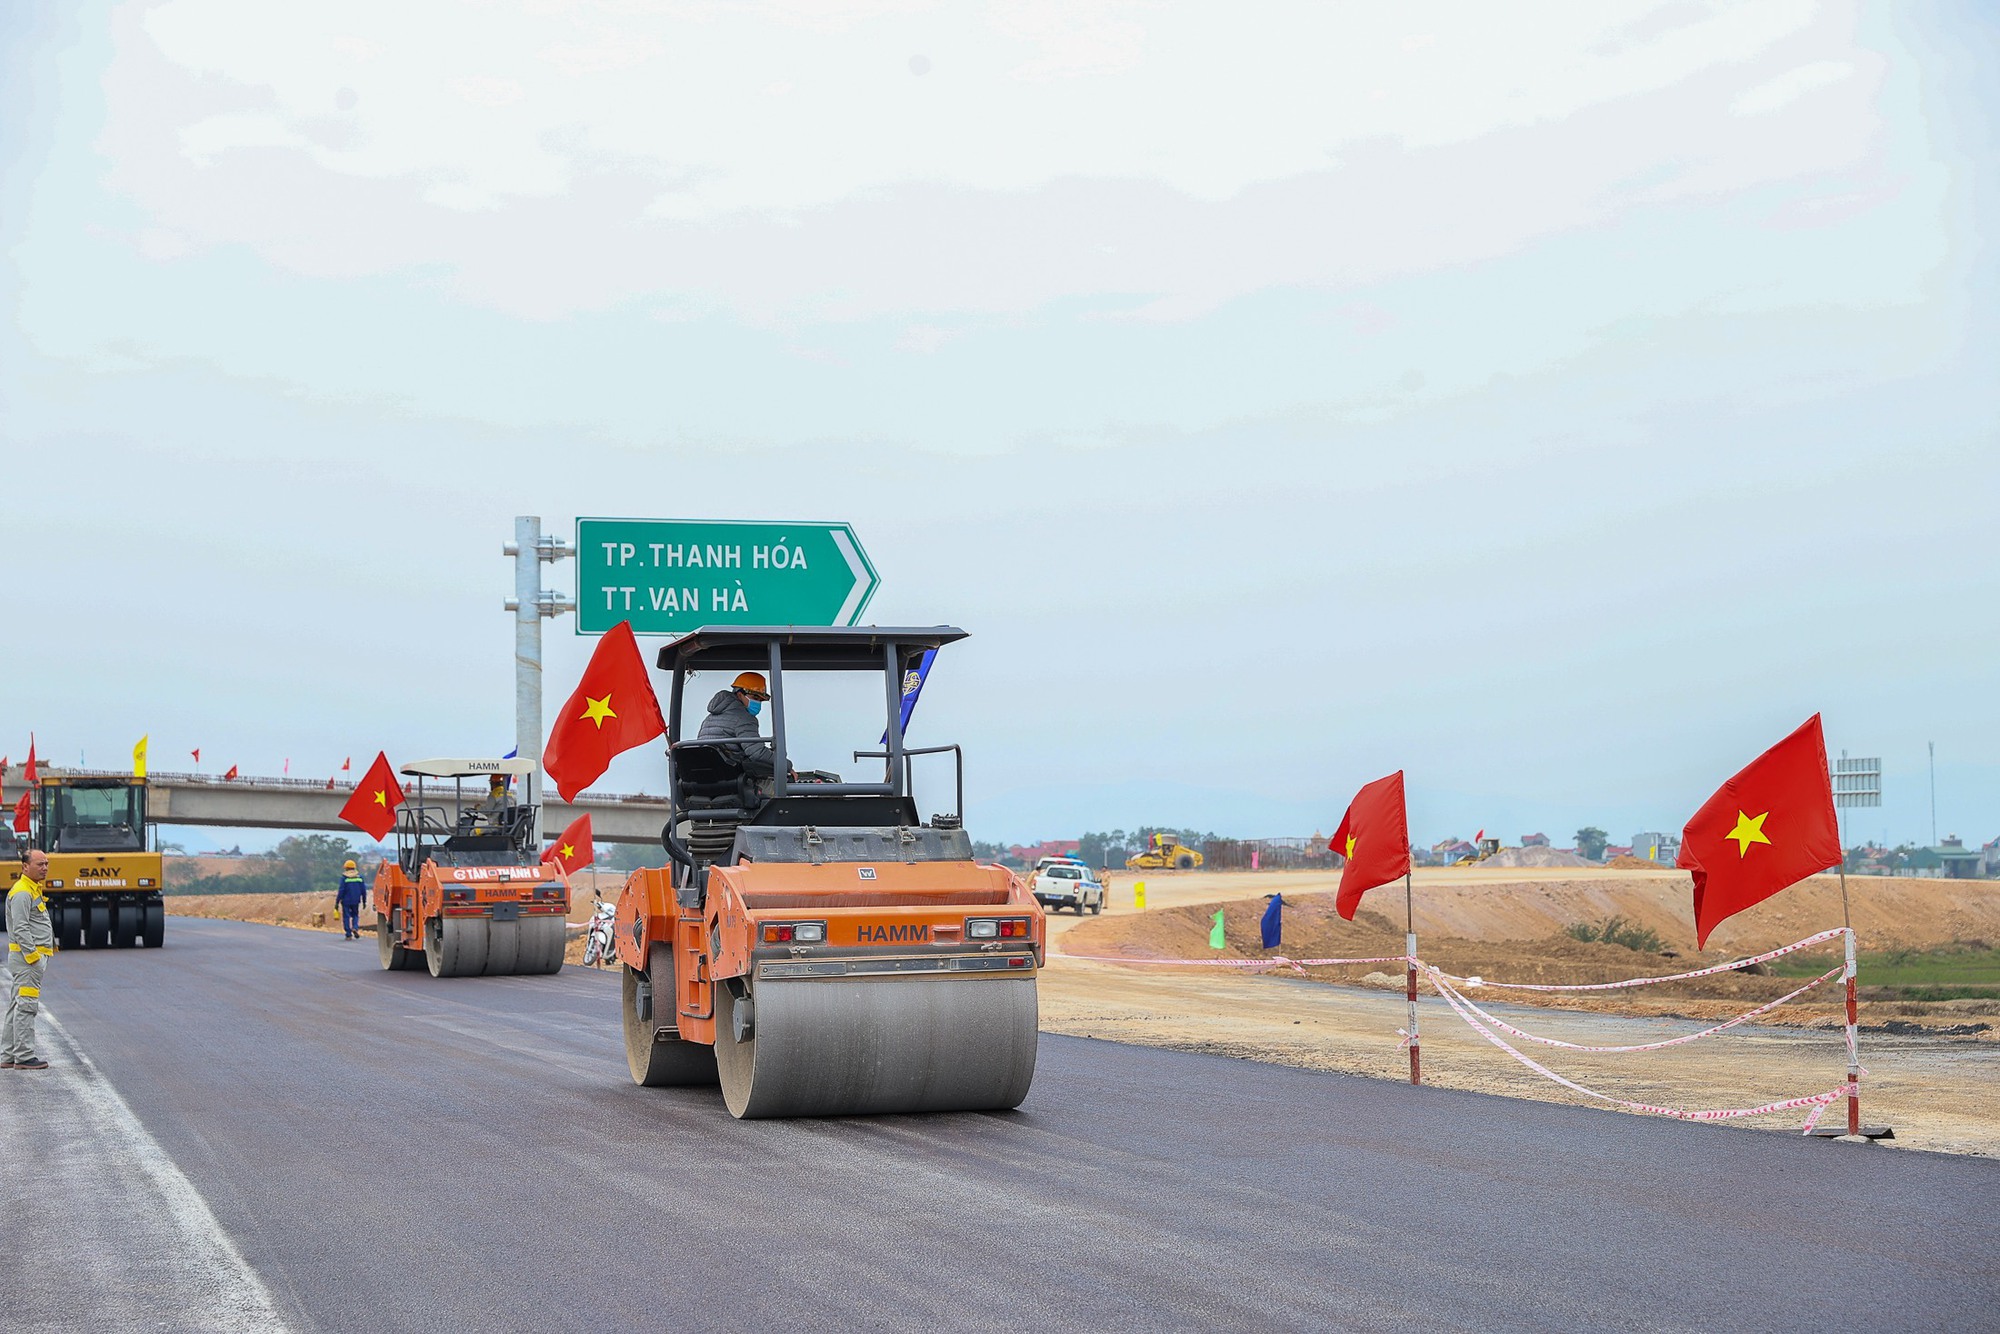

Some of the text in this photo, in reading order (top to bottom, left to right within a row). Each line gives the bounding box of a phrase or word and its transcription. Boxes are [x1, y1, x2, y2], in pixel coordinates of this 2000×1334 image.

[752, 536, 808, 570] HÓA
[712, 579, 749, 612] HÀ
[468, 762, 500, 771] HAMM
[79, 867, 121, 878] SANY
[484, 889, 517, 898] HAMM
[857, 925, 928, 942] HAMM
